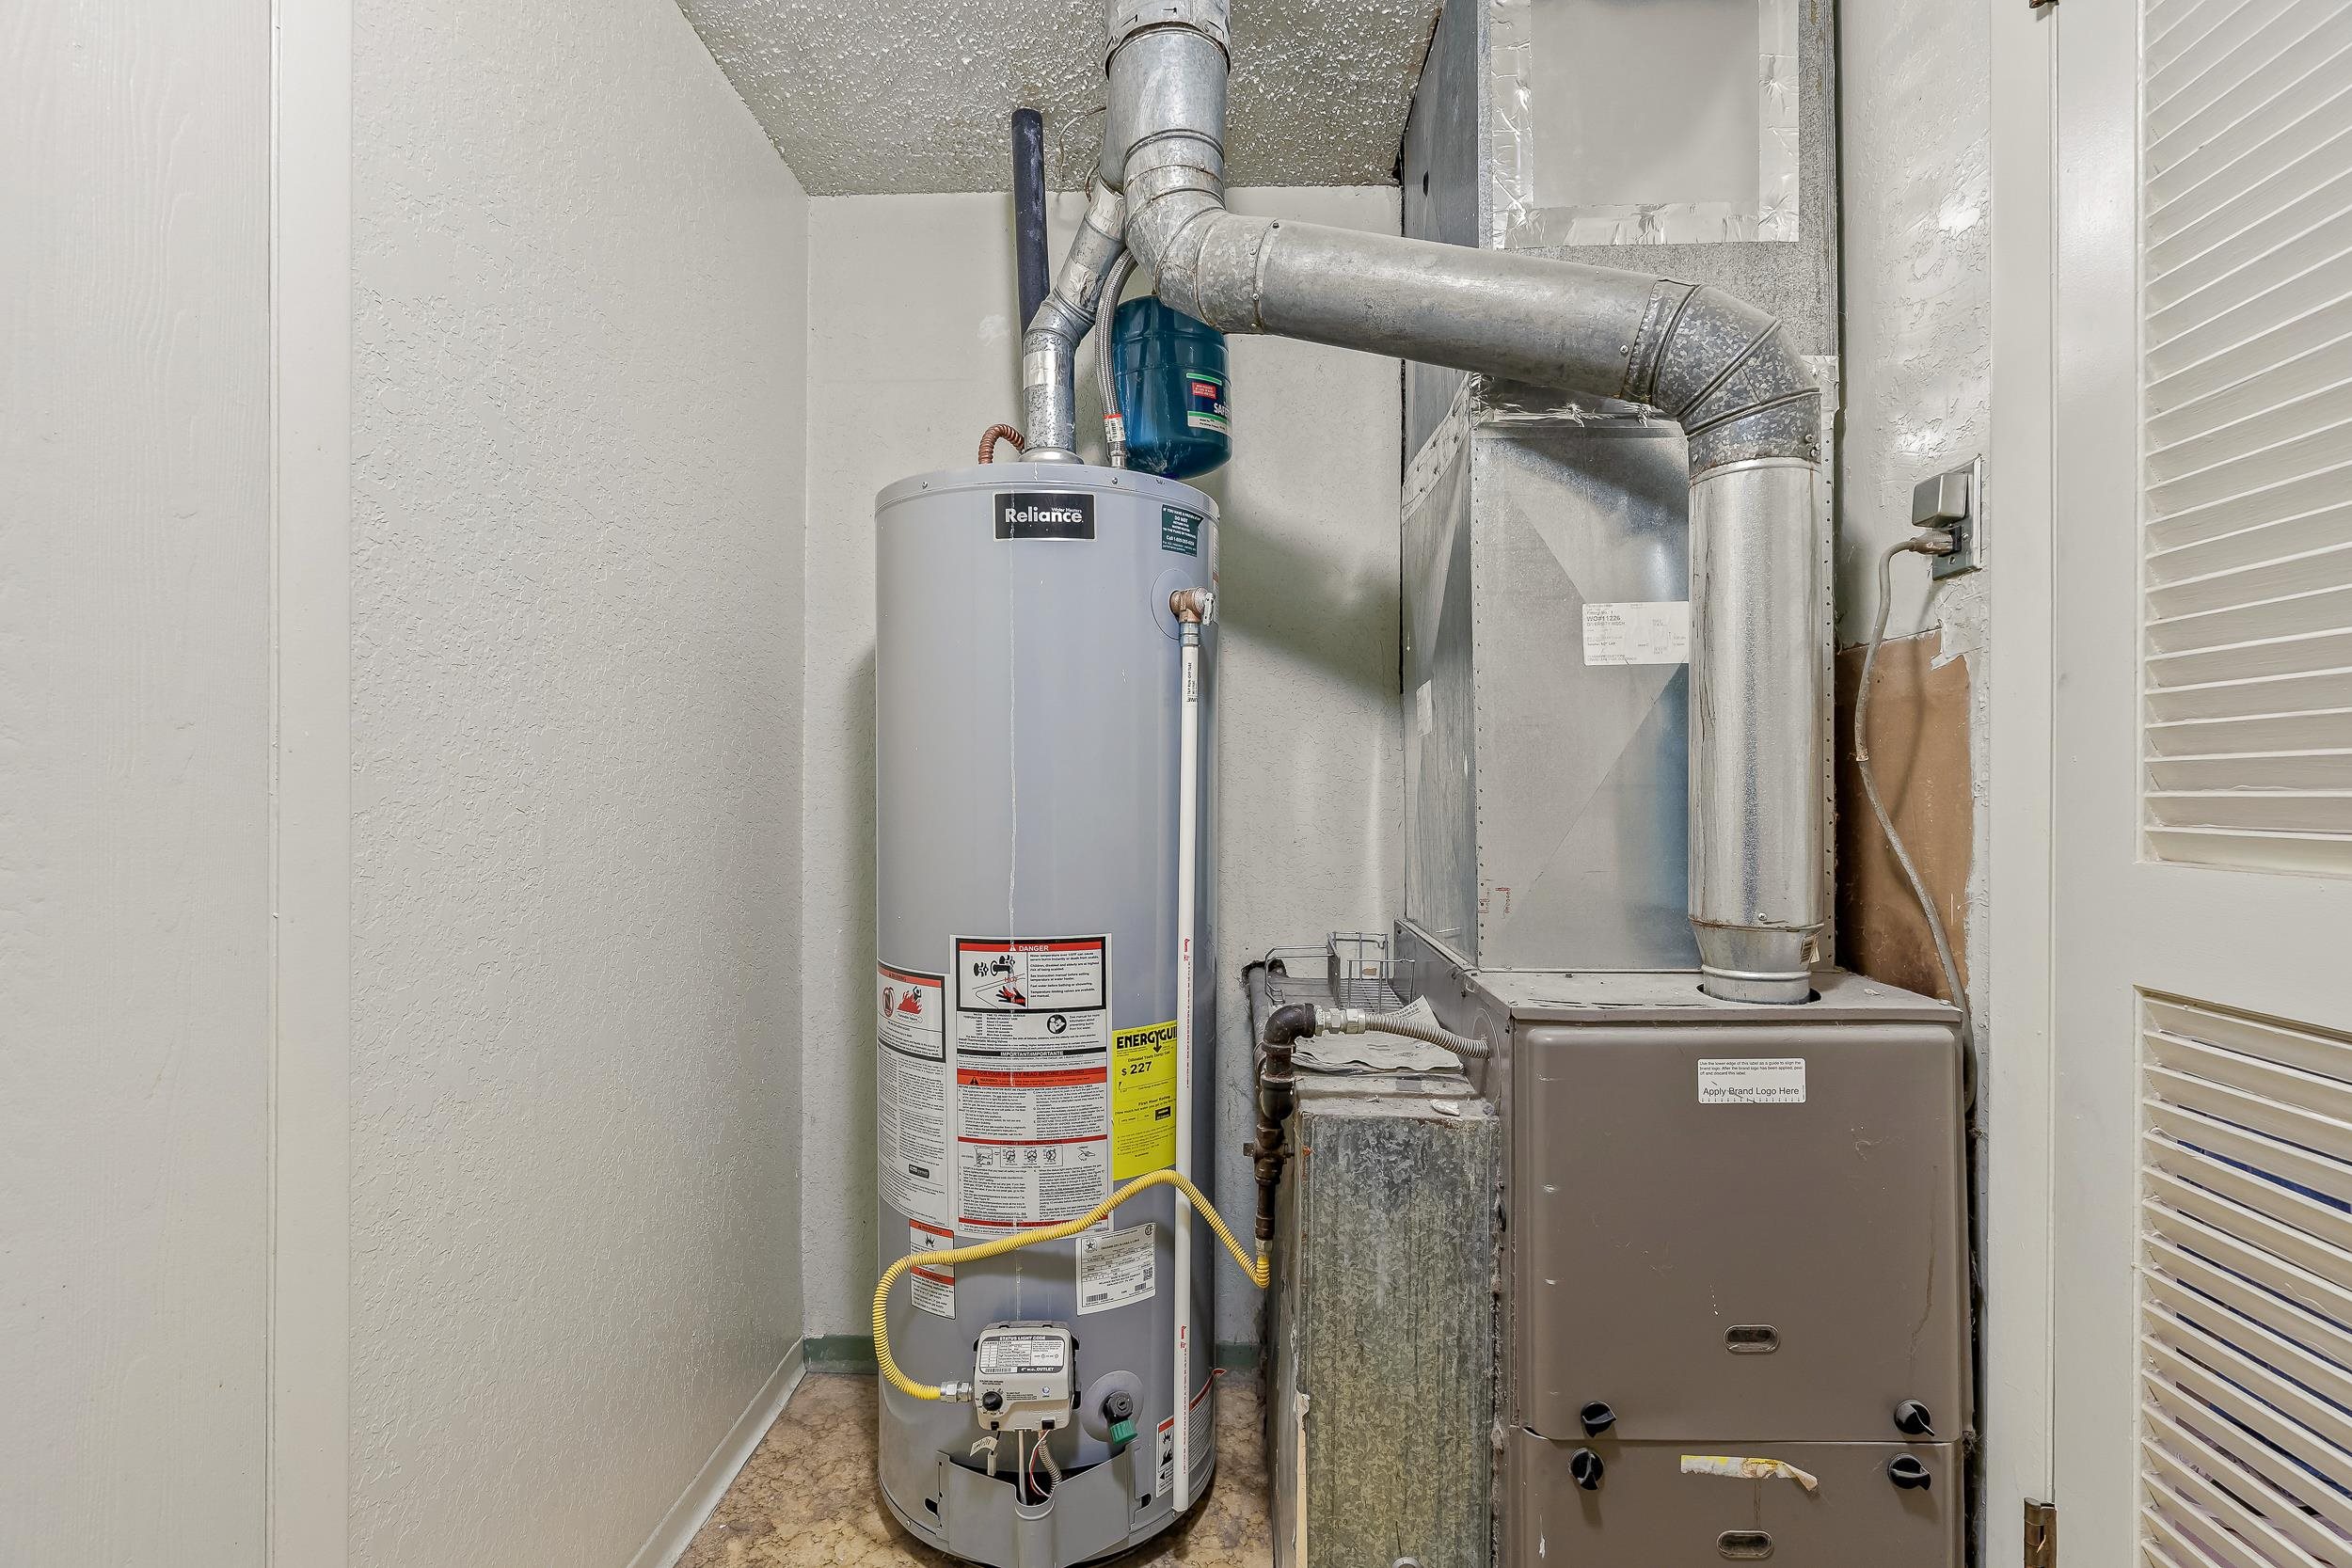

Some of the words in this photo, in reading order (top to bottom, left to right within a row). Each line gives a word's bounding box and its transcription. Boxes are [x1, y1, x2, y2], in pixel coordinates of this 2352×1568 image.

[1005, 506, 1082, 523] Reliance
[1130, 1061, 1152, 1074] 227
[1703, 1087, 1726, 1097] Apply
[1756, 1087, 1776, 1096] Logo
